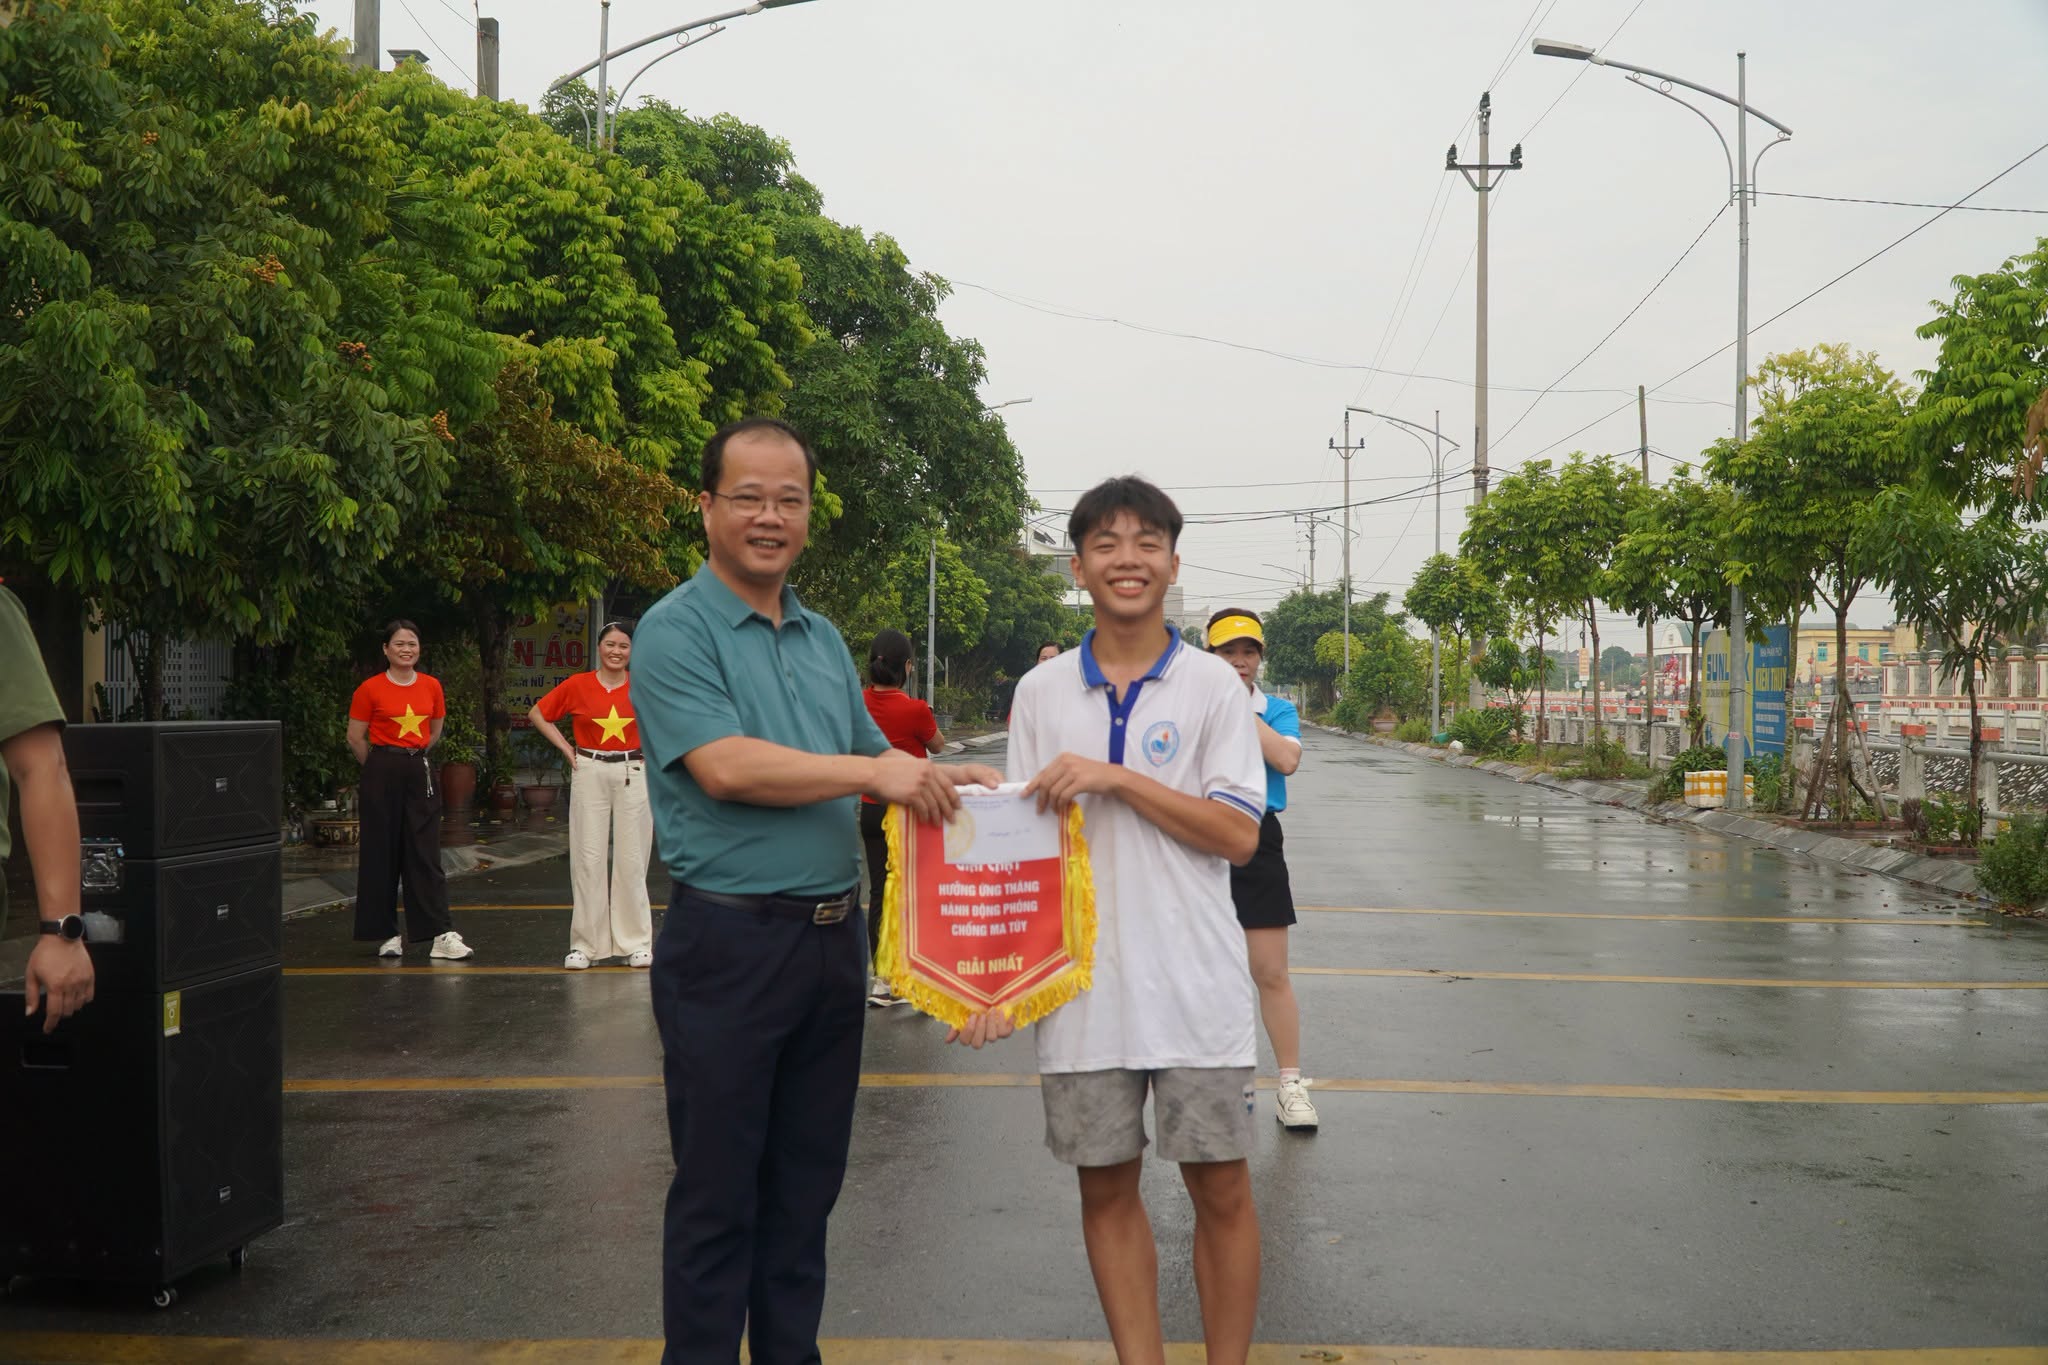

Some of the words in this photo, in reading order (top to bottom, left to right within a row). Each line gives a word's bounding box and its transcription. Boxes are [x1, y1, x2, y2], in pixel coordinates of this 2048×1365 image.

[544, 632, 585, 667] ÁO
[1004, 880, 1040, 895] THÁNG
[971, 902, 1001, 919] ĐỘNG
[951, 920, 987, 936] CHỐNG
[989, 923, 1007, 936] MA
[956, 955, 985, 975] GIẢI
[988, 951, 1024, 974] NHẤT
